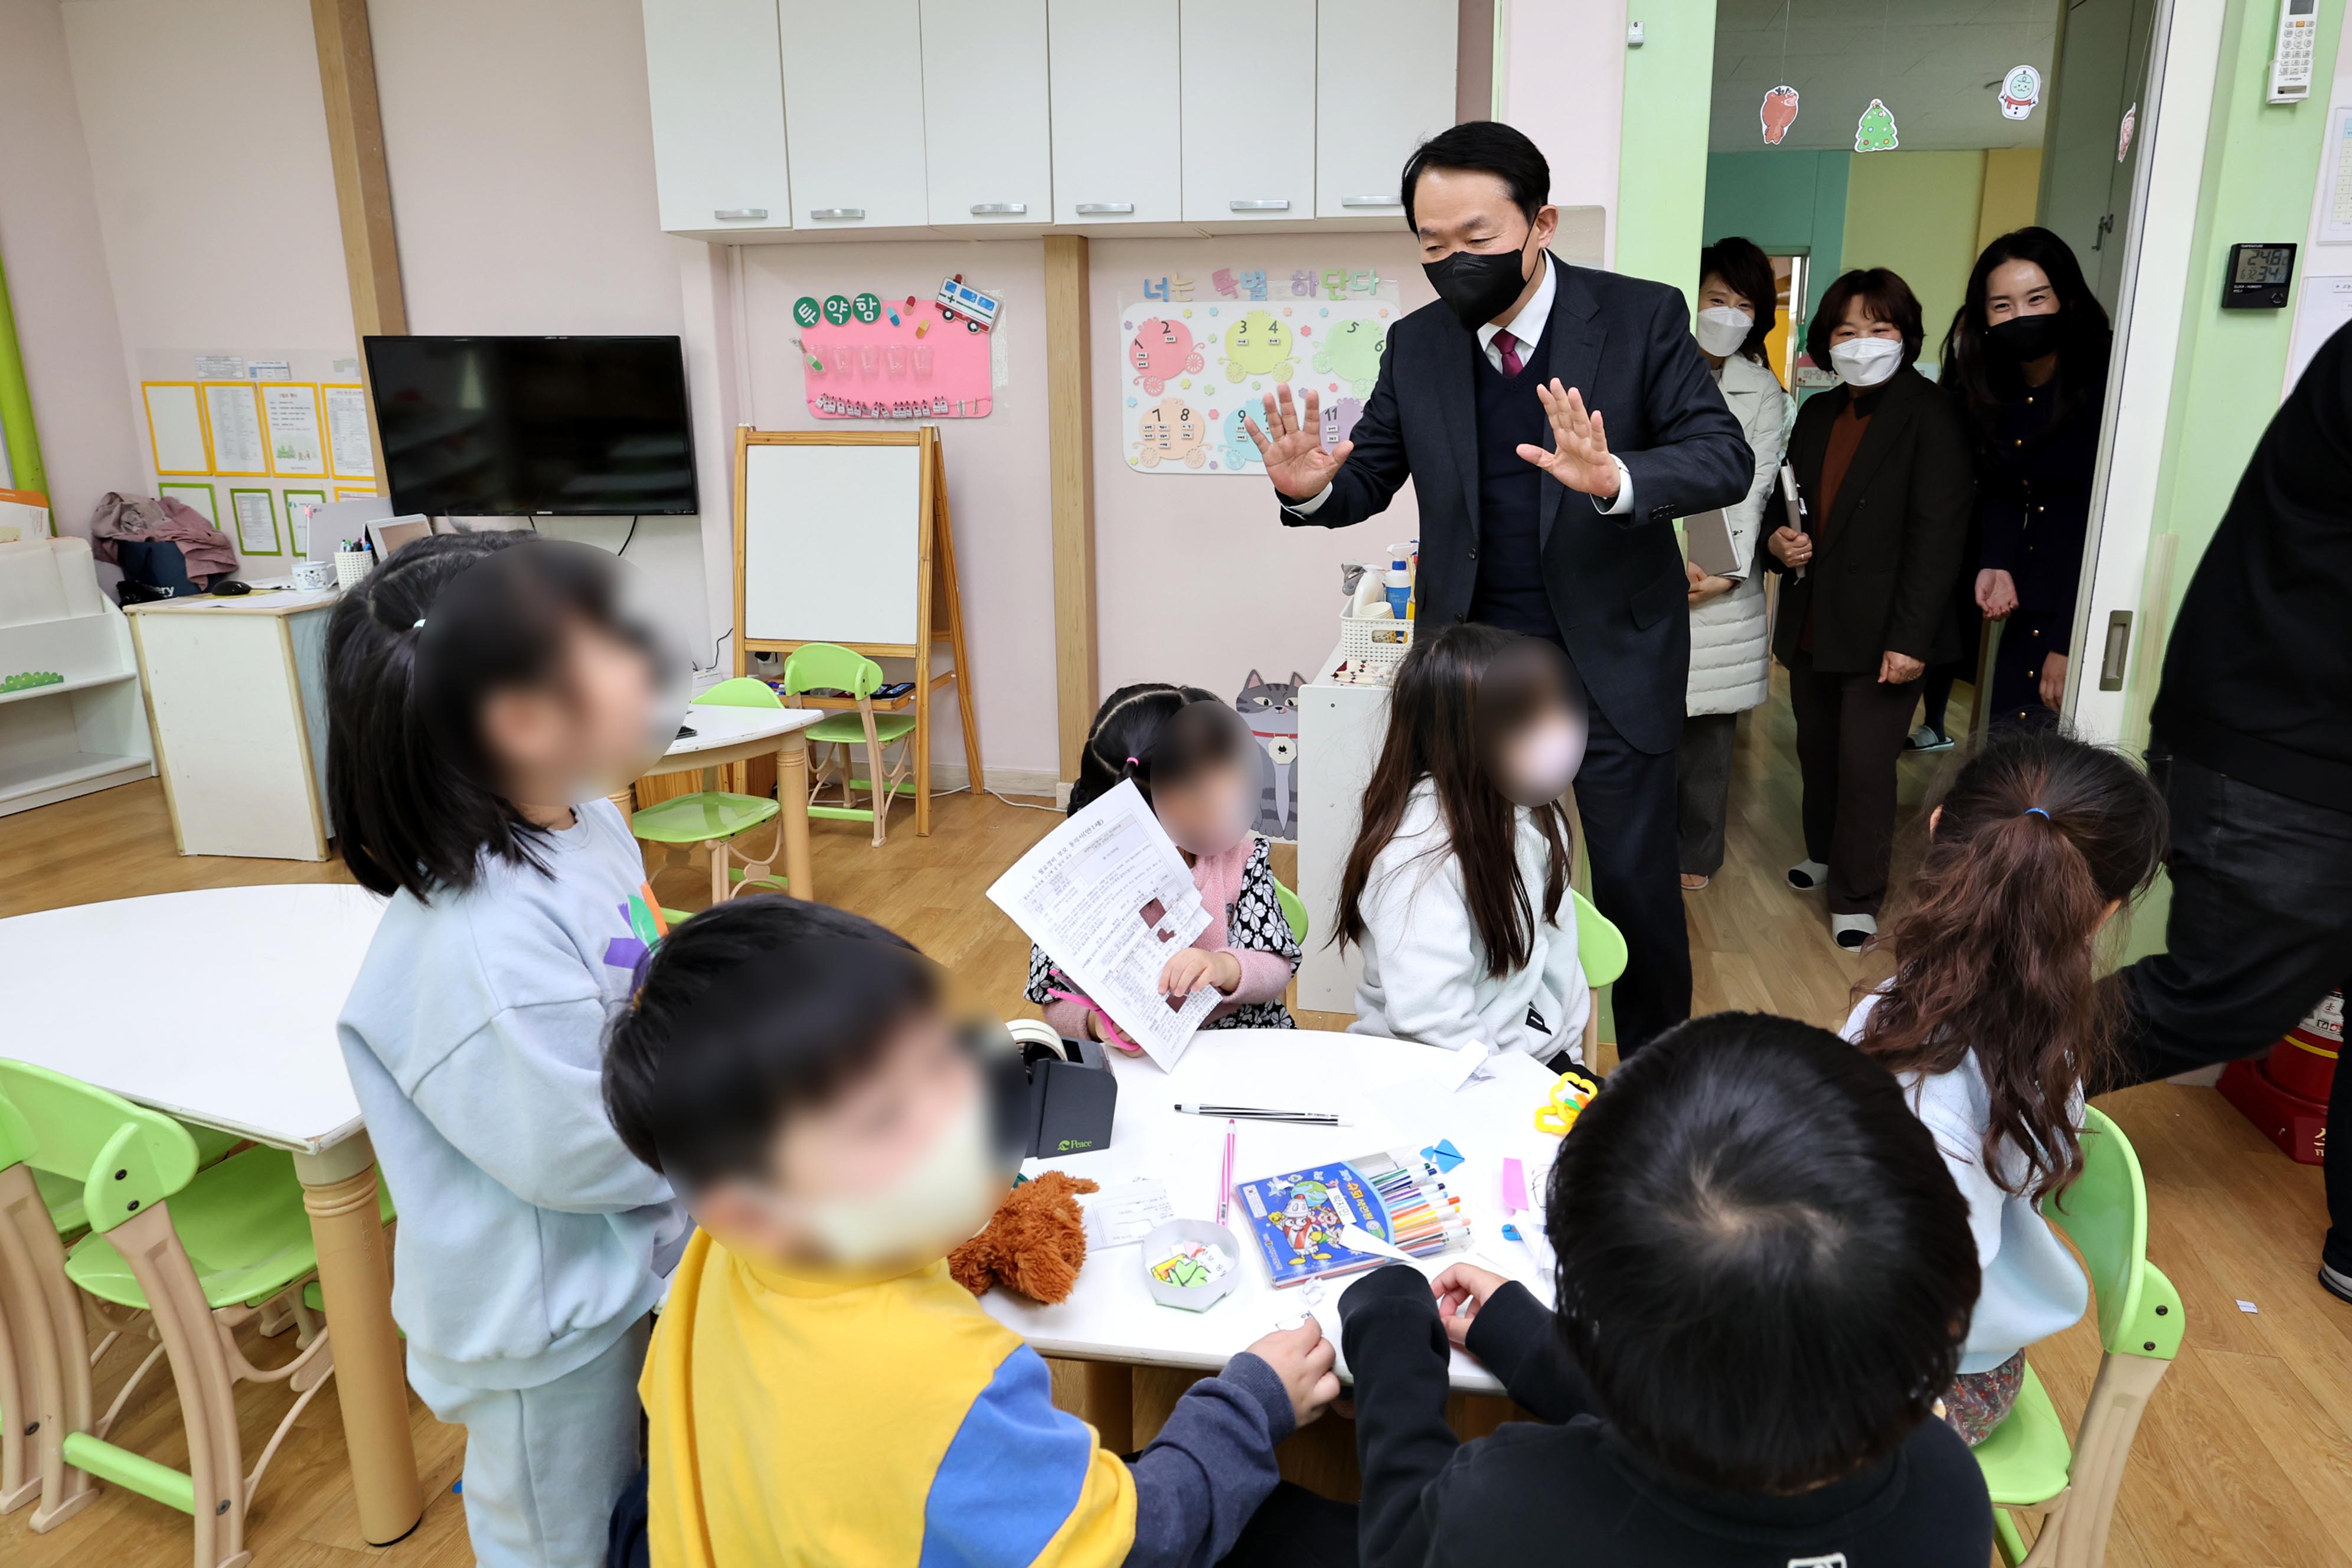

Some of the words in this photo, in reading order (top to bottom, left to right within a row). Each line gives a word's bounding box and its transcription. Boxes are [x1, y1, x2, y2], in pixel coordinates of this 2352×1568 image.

[1144, 272, 1195, 302] 너는
[1212, 267, 1268, 300] 특별
[1291, 267, 1380, 300] 하단다
[798, 297, 877, 324] 투약함
[1161, 321, 1171, 334] 2
[1239, 320, 1247, 334] 3
[1268, 320, 1278, 334] 4
[1347, 321, 1360, 333] 5
[1134, 338, 1144, 349] 1
[1374, 340, 1384, 352] 6
[1152, 408, 1161, 422] 7
[1180, 408, 1190, 421] 8
[1238, 410, 1246, 423] 9
[1325, 407, 1338, 422] 11
[1071, 1139, 1092, 1149] Peace
[1333, 1195, 1351, 1216] 박지민
